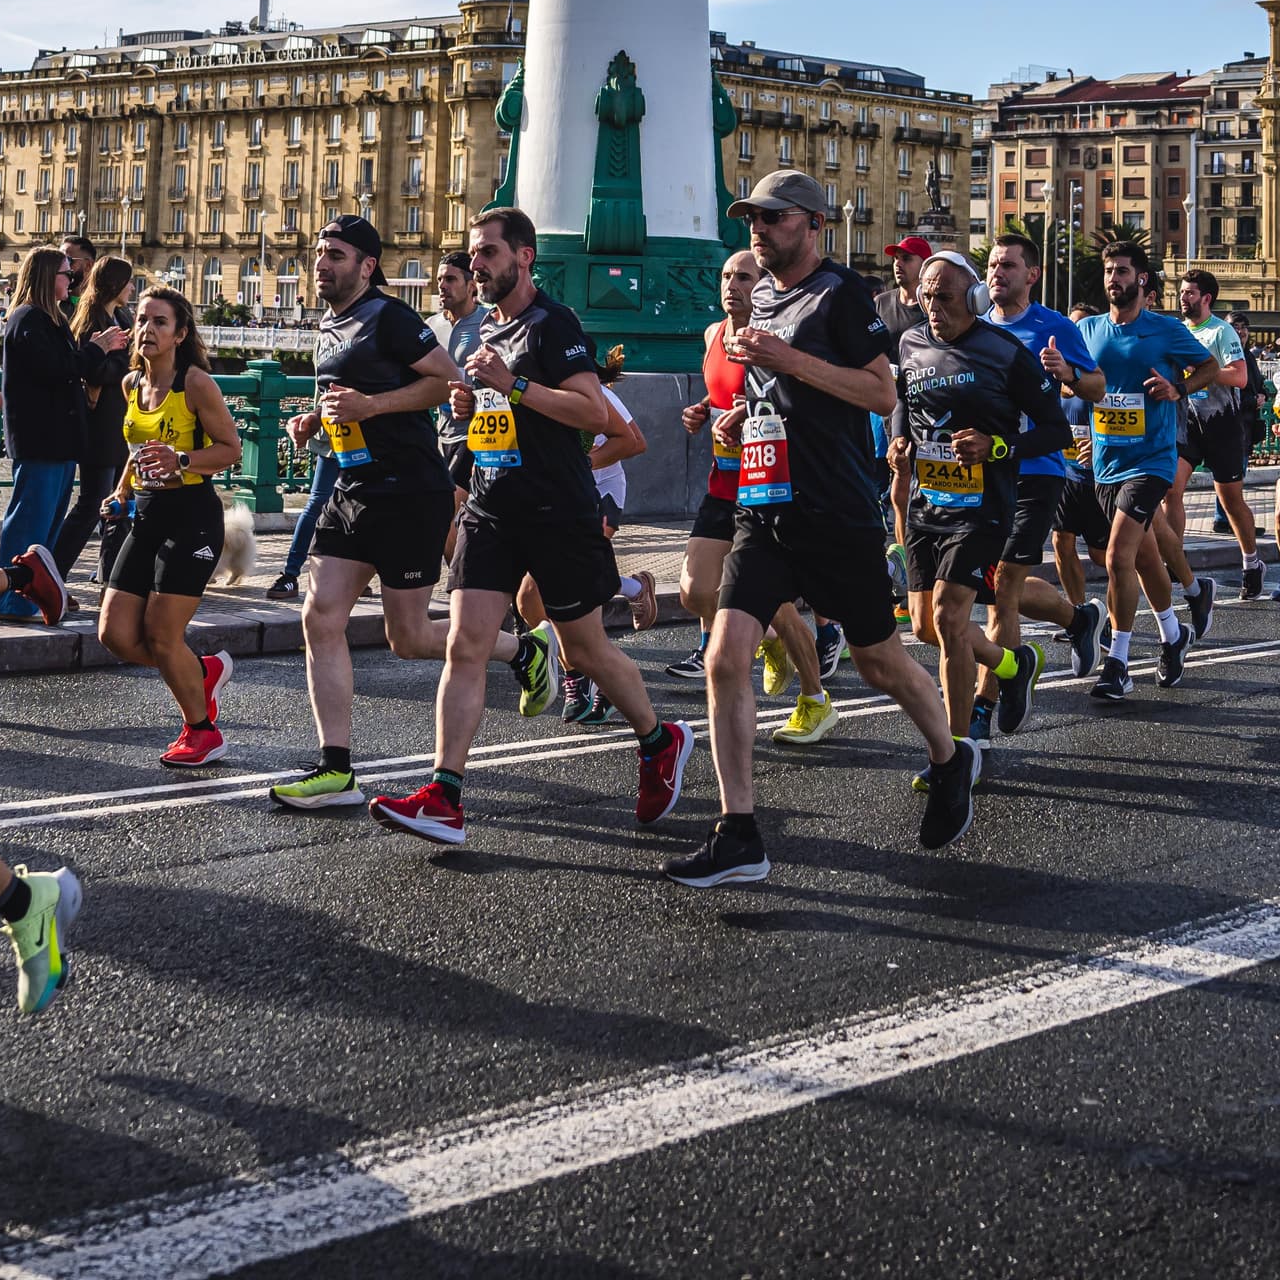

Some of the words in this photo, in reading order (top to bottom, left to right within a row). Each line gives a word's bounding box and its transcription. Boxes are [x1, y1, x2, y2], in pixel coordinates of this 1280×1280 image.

[773, 323, 796, 339] TION
[867, 319, 884, 333] sal
[906, 366, 936, 384] SALTO
[907, 371, 975, 398] FOUNDATION
[472, 414, 509, 435] 2299
[1098, 410, 1138, 425] 2235
[743, 444, 776, 470] 3218
[937, 445, 957, 460] 15
[925, 463, 974, 481] 2441
[404, 570, 423, 580] GORE
